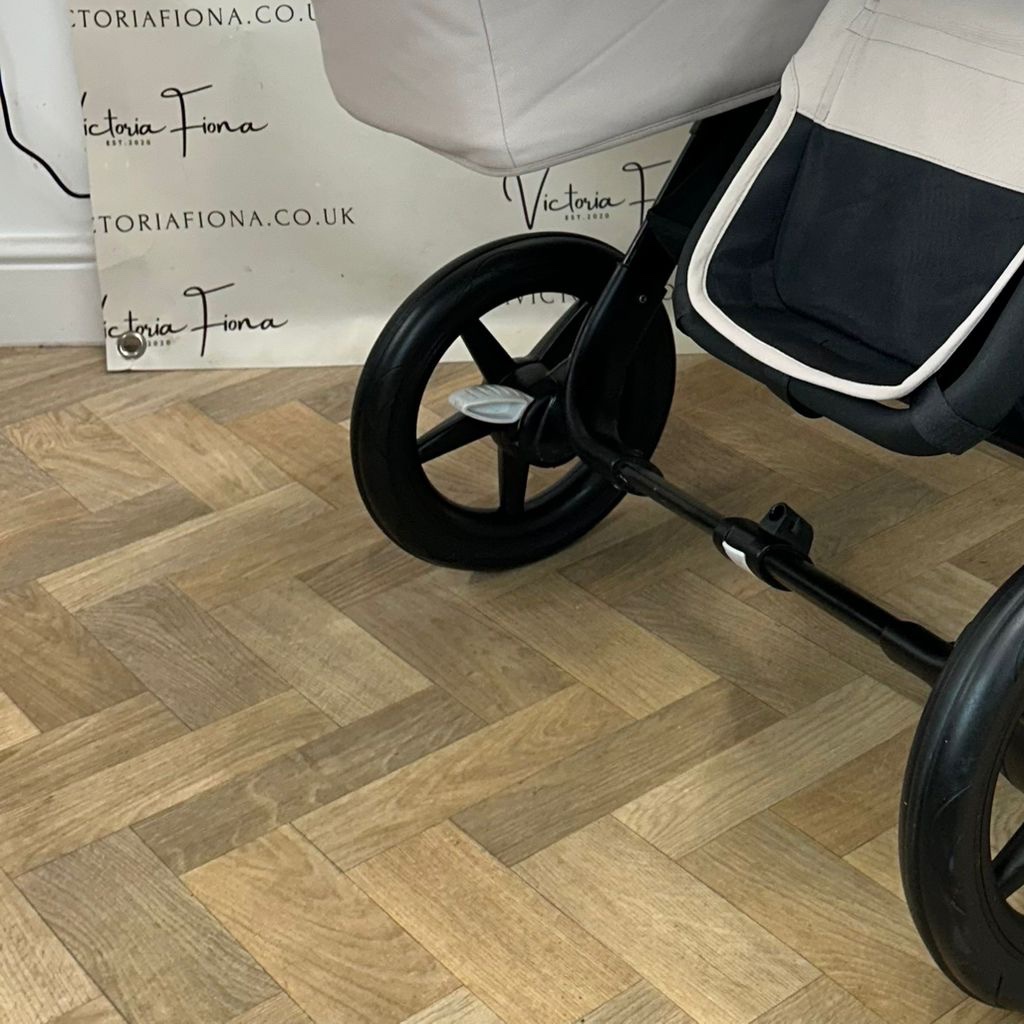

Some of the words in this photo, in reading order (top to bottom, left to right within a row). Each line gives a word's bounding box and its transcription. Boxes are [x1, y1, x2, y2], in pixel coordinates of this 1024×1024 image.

[81, 92, 167, 138] ictoria
[161, 85, 269, 158] Fiona
[91, 207, 355, 234] TORIAFIONA.CO.UK
[503, 167, 626, 230] Victoria
[183, 283, 288, 357] Fiona
